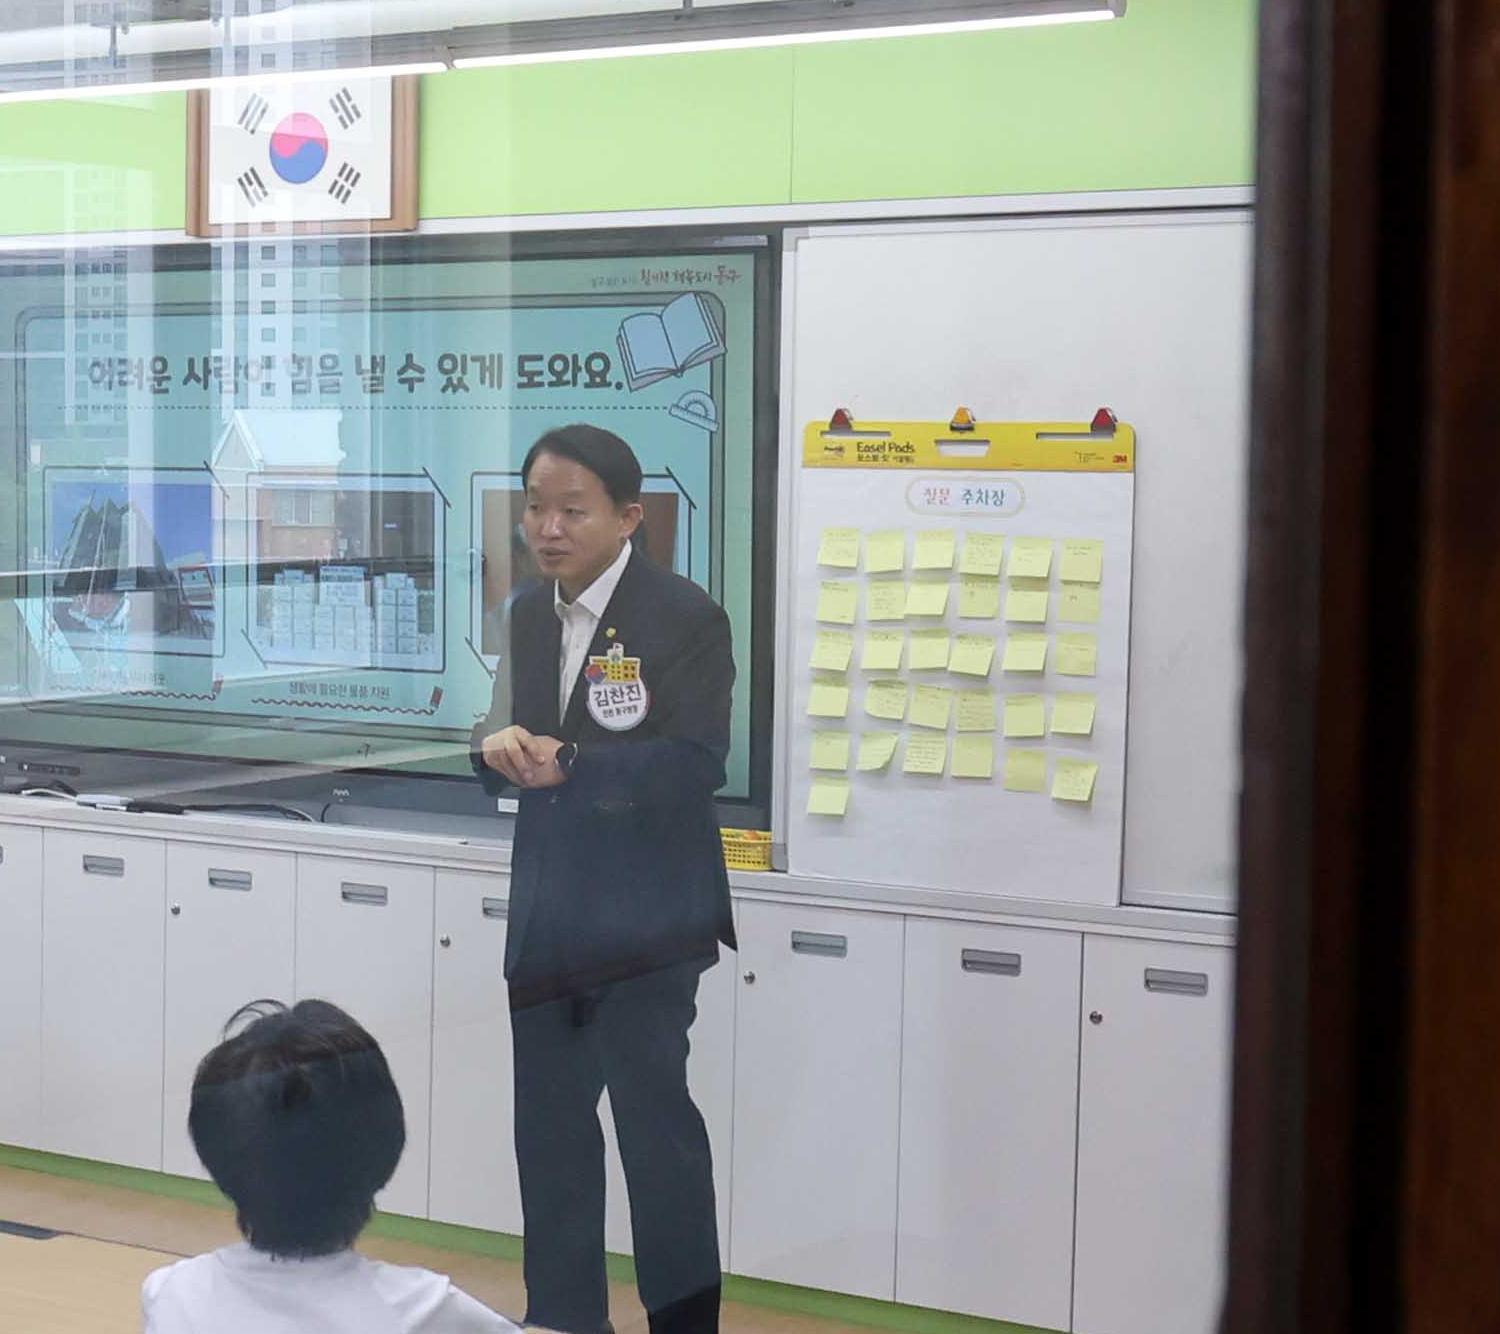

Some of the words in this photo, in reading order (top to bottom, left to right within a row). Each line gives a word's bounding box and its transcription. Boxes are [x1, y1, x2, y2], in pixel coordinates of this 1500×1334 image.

[88, 355, 171, 396] 어려운
[181, 355, 273, 396] 사람이
[283, 352, 343, 396] 힘을
[354, 354, 387, 395] 낼
[396, 352, 426, 394] 수
[437, 352, 504, 395] 있게
[516, 351, 624, 390] 도와요.
[856, 441, 886, 453] Easel
[888, 442, 915, 454] Pads
[1111, 453, 1128, 465] 3M
[961, 487, 1005, 507] 주차장
[593, 684, 641, 708] 김찬진
